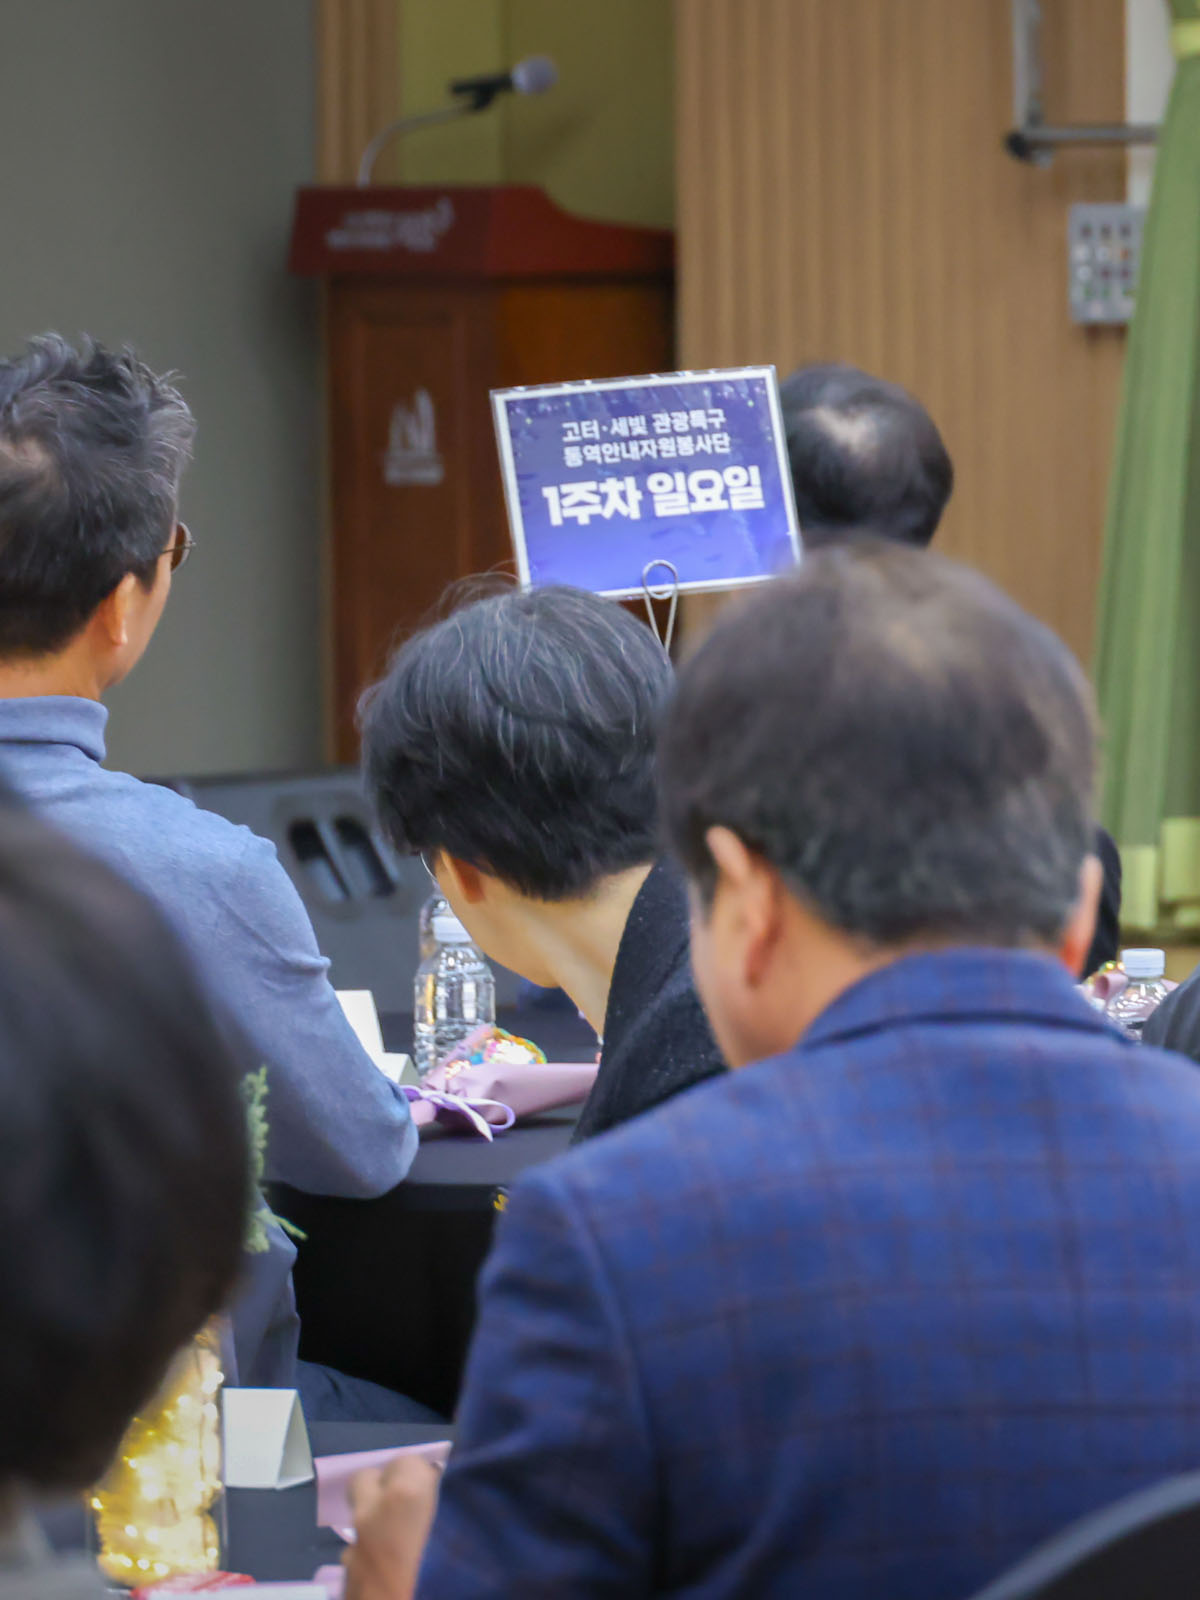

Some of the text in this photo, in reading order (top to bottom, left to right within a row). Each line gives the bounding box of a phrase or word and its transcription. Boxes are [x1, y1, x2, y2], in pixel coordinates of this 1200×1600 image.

[562, 408, 727, 442] 고터·세빛 관광특구
[563, 433, 731, 467] 통역안내자원봉사단
[542, 466, 765, 526] 1주차 일요일
